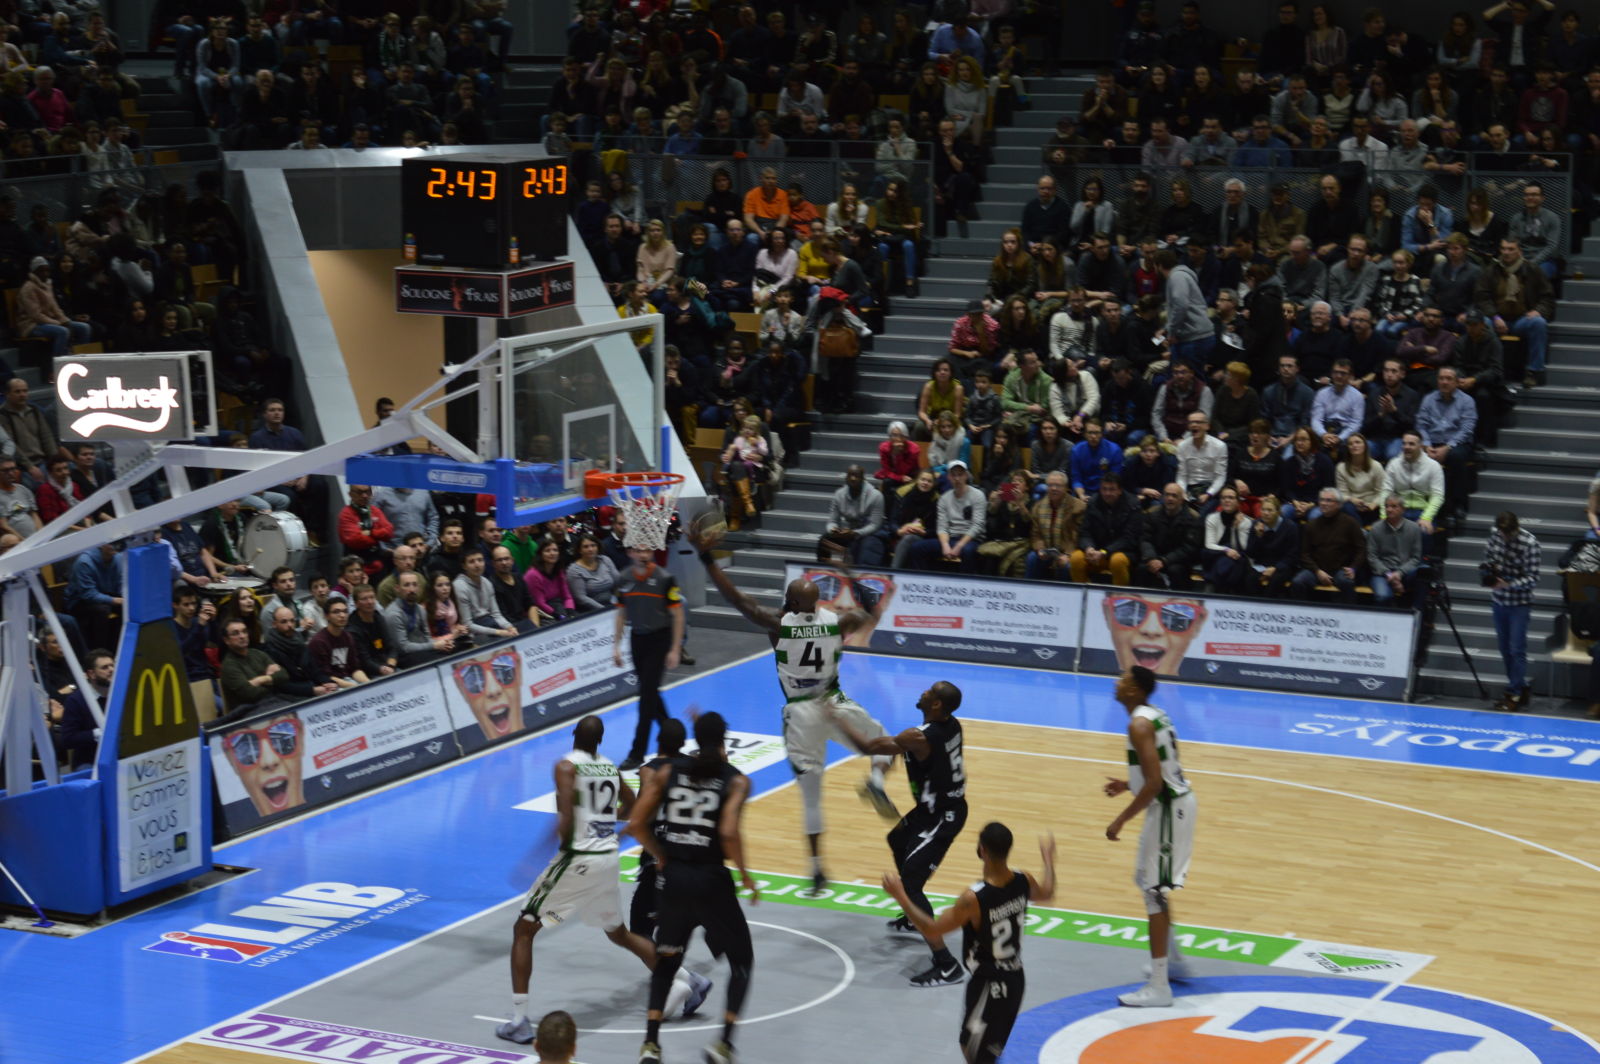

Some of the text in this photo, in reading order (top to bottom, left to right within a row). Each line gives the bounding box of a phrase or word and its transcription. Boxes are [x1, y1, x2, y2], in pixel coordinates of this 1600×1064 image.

[427, 168, 497, 200] 2:43
[523, 165, 567, 198] 2:43
[400, 284, 499, 303] SOLOGNE FRAIS
[901, 583, 932, 594] NOUS
[934, 585, 967, 597] AVONS
[901, 594, 934, 606] VOTRE
[986, 601, 1001, 611] DE
[1003, 602, 1055, 615] PASSIONS
[1213, 608, 1246, 620] NOUS
[1249, 611, 1286, 623] AVONS
[791, 626, 831, 638] FAIRELL
[1213, 620, 1250, 633] VOTRE
[1306, 627, 1322, 639] DE
[1325, 630, 1381, 644] PASSIONS
[798, 641, 825, 673] 4
[306, 710, 331, 725] NOUS
[311, 722, 339, 739] VOTRE
[589, 780, 615, 815] 12
[668, 786, 720, 828] 22
[188, 882, 405, 944] LNB
[246, 949, 298, 968] LIGUE
[294, 920, 371, 951] NATIONALE
[367, 1030, 426, 1045] SERVICES
[440, 1043, 489, 1055] OUTILS
